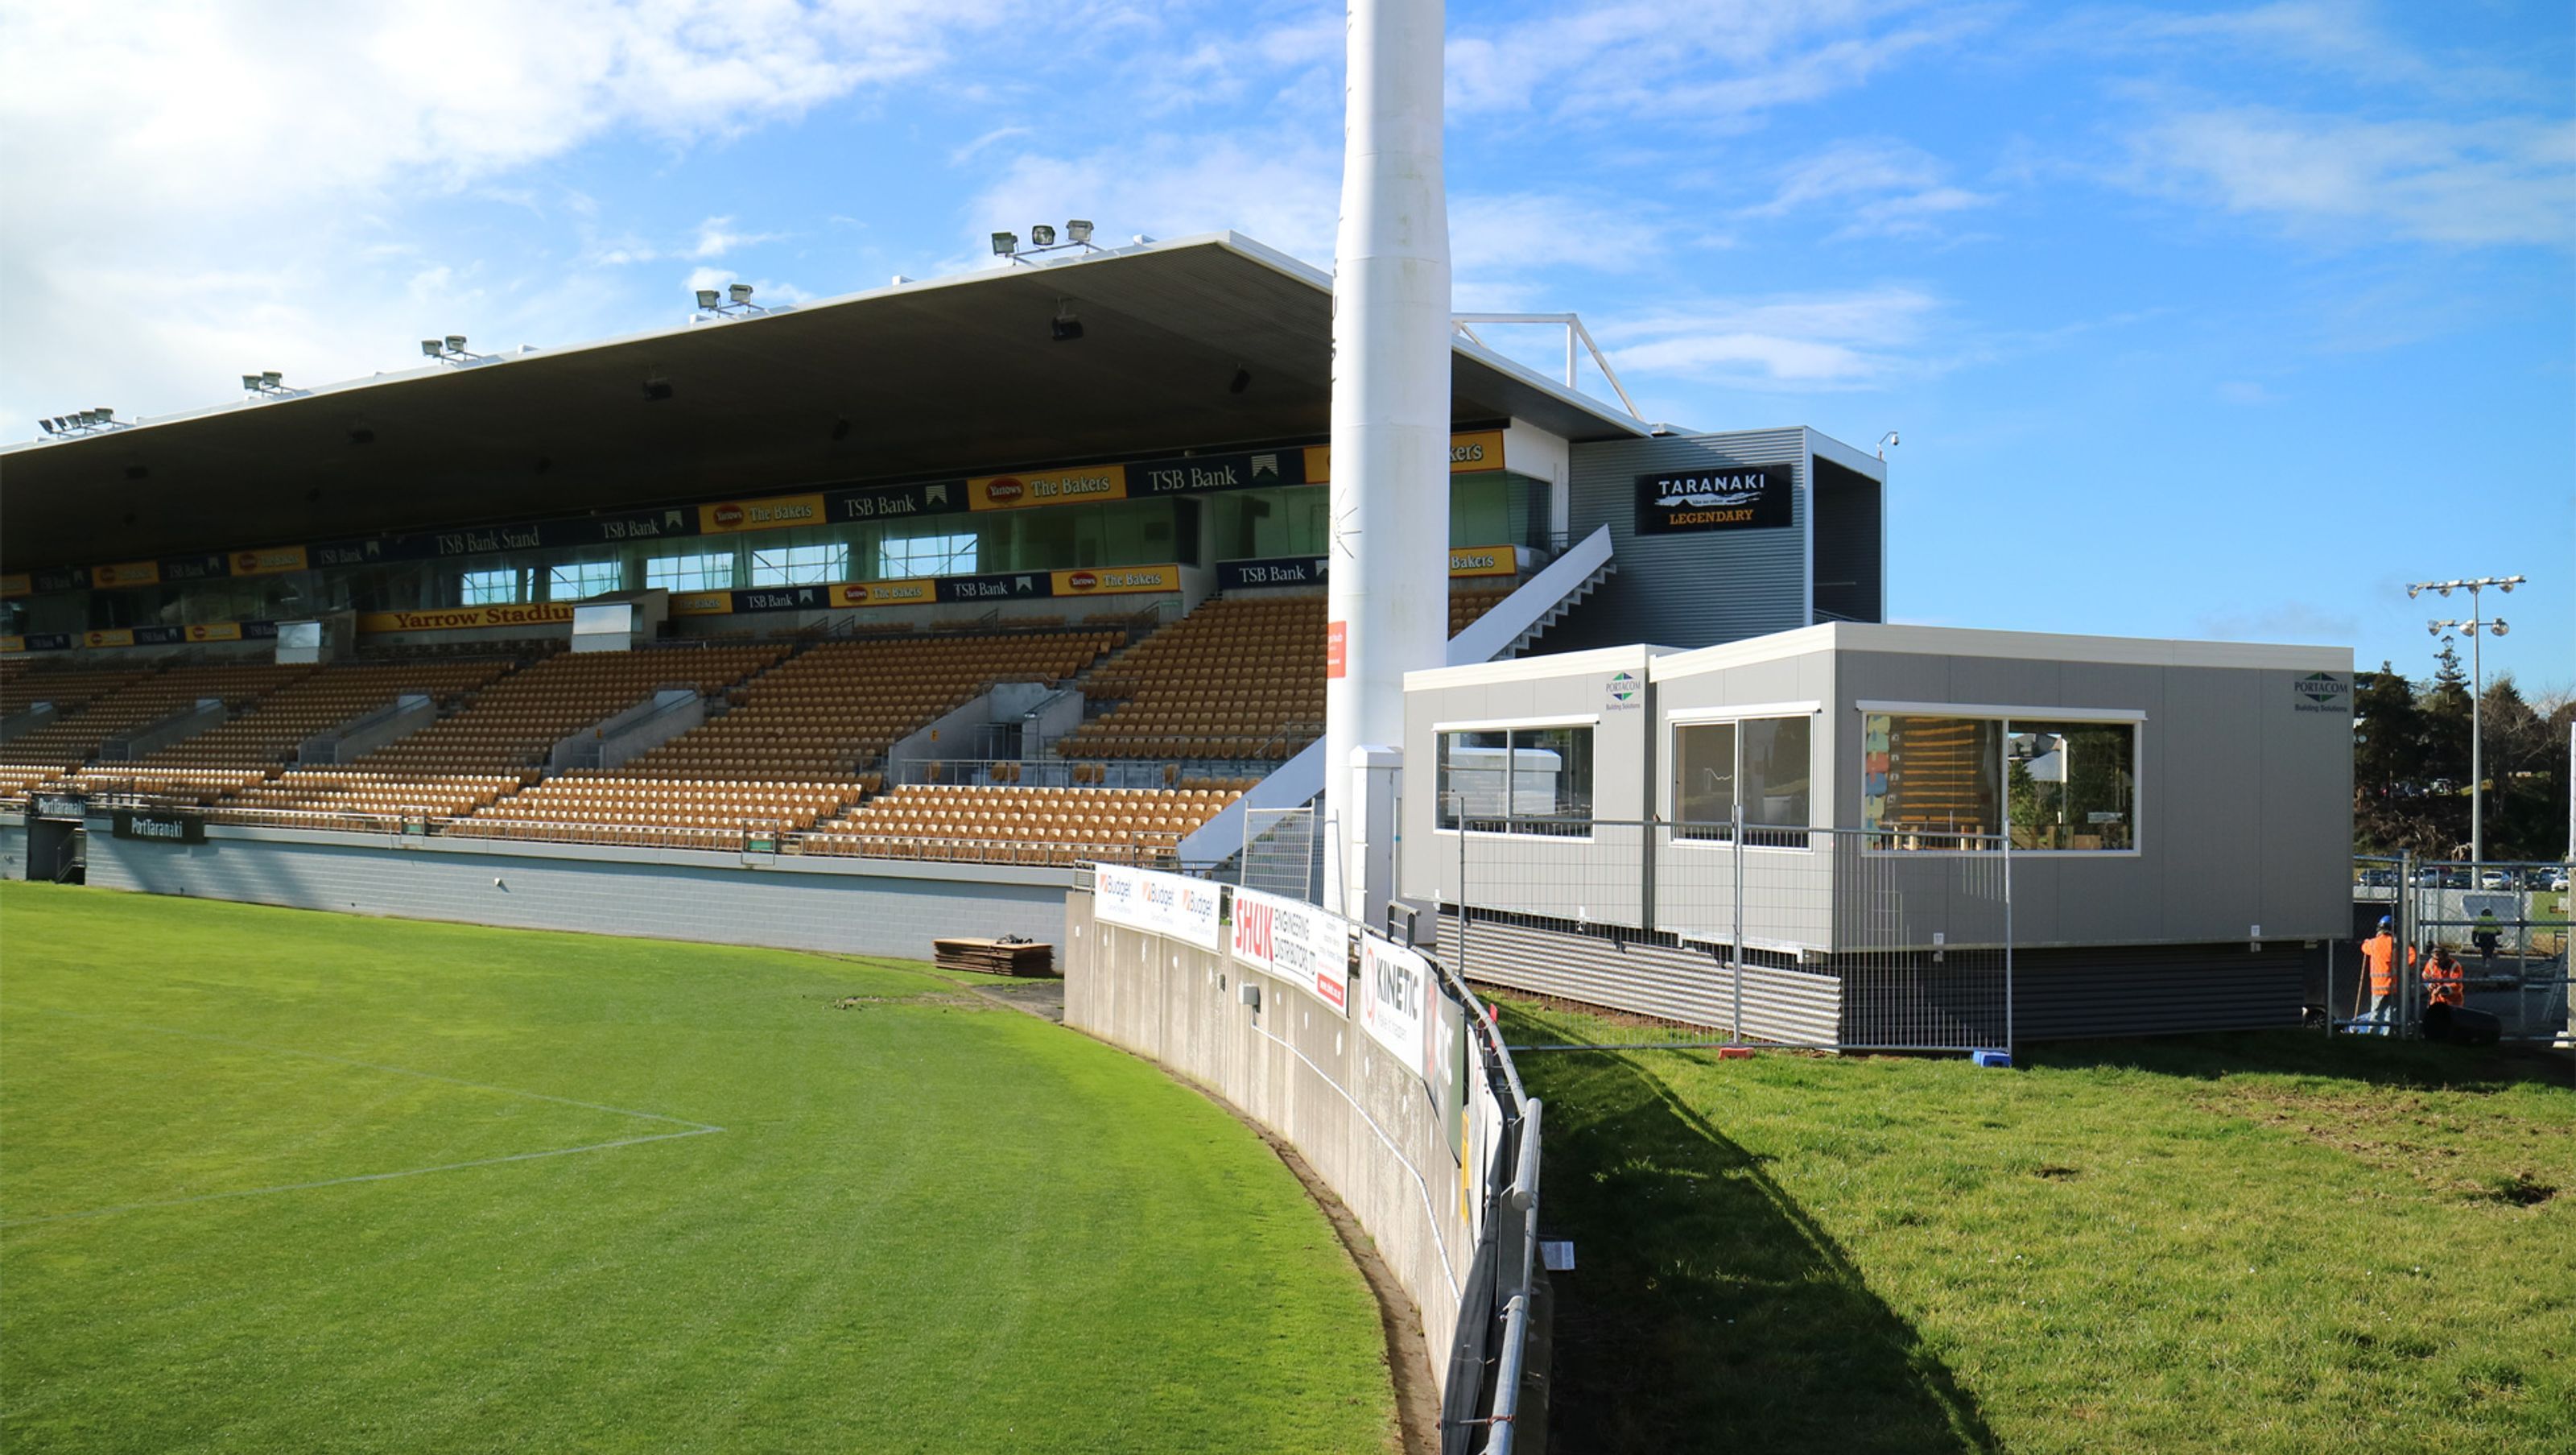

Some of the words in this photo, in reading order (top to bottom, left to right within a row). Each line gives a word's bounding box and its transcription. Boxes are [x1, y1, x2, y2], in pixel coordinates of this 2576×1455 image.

[1031, 480, 1058, 498] The
[1148, 469, 1184, 491] TSB
[1191, 465, 1238, 488] Bank
[1657, 473, 1765, 495] TARANAKI
[749, 507, 770, 522] The
[844, 498, 873, 517] TSB
[877, 494, 917, 515] Bank
[1669, 509, 1753, 525] LEGENDARY
[436, 535, 464, 555] TSB
[467, 531, 499, 552] Bank
[502, 525, 541, 548] Stand
[601, 522, 625, 539] TSB
[628, 519, 660, 537] Bank
[1103, 574, 1123, 587] The
[1240, 567, 1266, 584] TSB
[1270, 564, 1307, 581] Bank
[953, 583, 976, 597] TSB
[979, 581, 1009, 596] Bank
[747, 595, 766, 609] TSB
[768, 593, 794, 608] Bank
[394, 611, 479, 629] Yarrow
[485, 603, 574, 624] Stadiu
[1606, 680, 1641, 692] PORTACOM
[2294, 681, 2348, 693] PORTACOM
[2295, 704, 2319, 713] Building
[1108, 874, 1131, 903] Budget
[1151, 882, 1174, 912] Budget
[1190, 890, 1213, 923] Budget
[1236, 898, 1274, 962] SHUK
[1275, 908, 1310, 941] ENGINEERING
[1275, 936, 1308, 973] DISTRIBUTORS
[1377, 957, 1418, 1021] KINETIC
